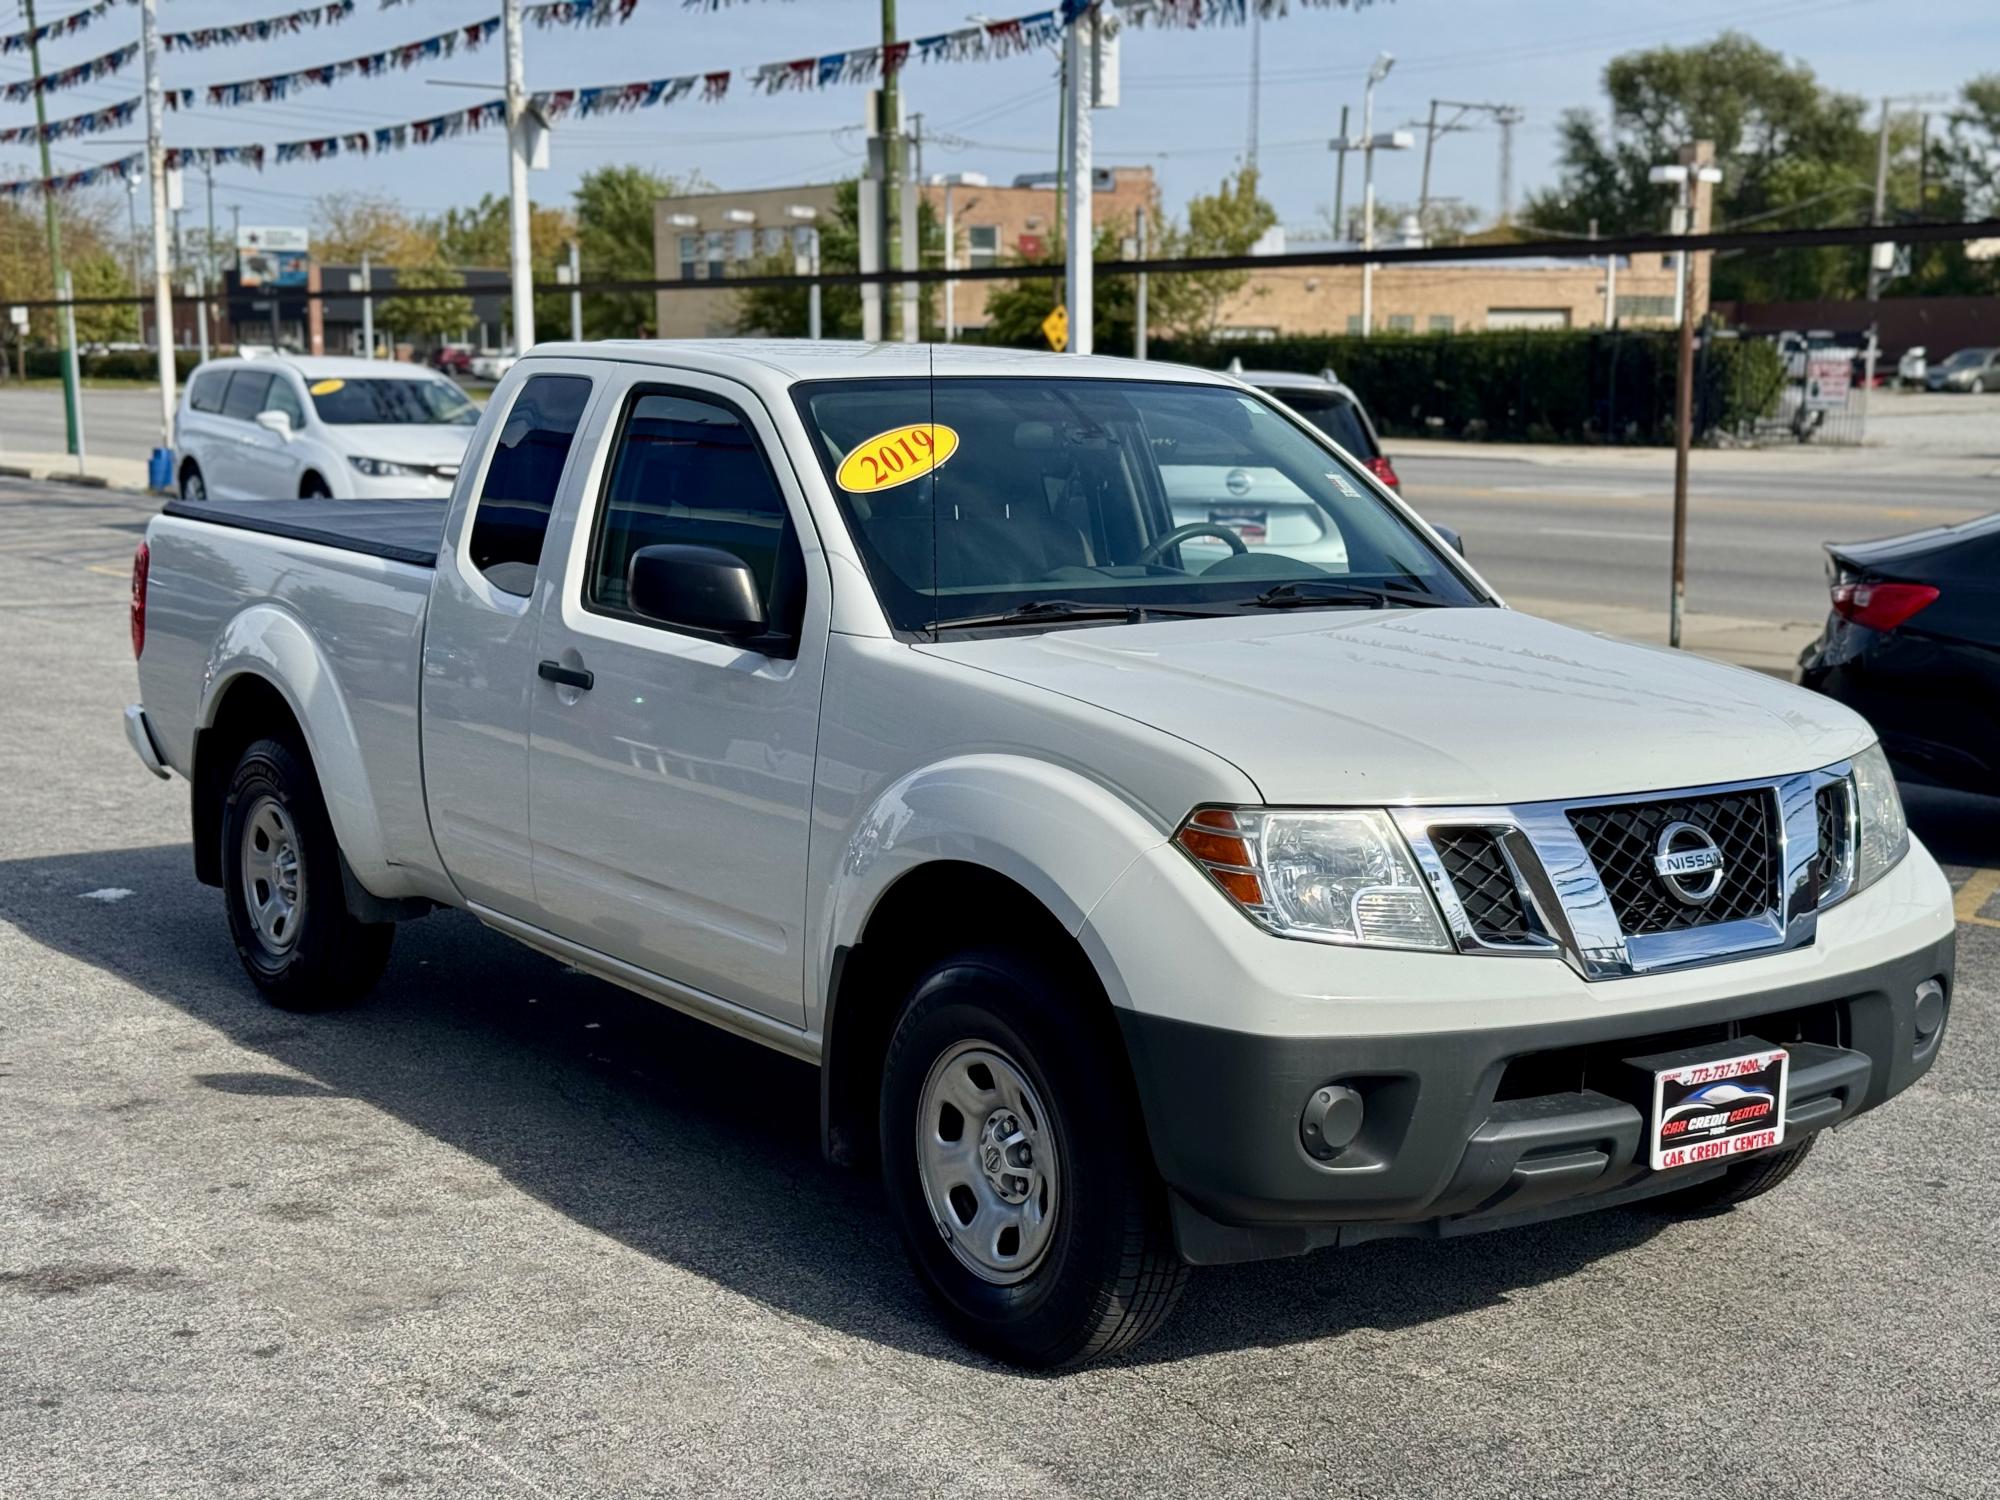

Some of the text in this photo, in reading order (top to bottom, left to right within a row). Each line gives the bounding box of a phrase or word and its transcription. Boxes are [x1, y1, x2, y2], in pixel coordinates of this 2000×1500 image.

[861, 430, 933, 485] 2019
[1666, 852, 1720, 870] NISSAN
[1690, 1059, 1759, 1084] 773-737-7600
[1662, 1103, 1770, 1135] CAR CREDIT CENTER
[1663, 1131, 1775, 1167] CAR CREDIT CENTER
